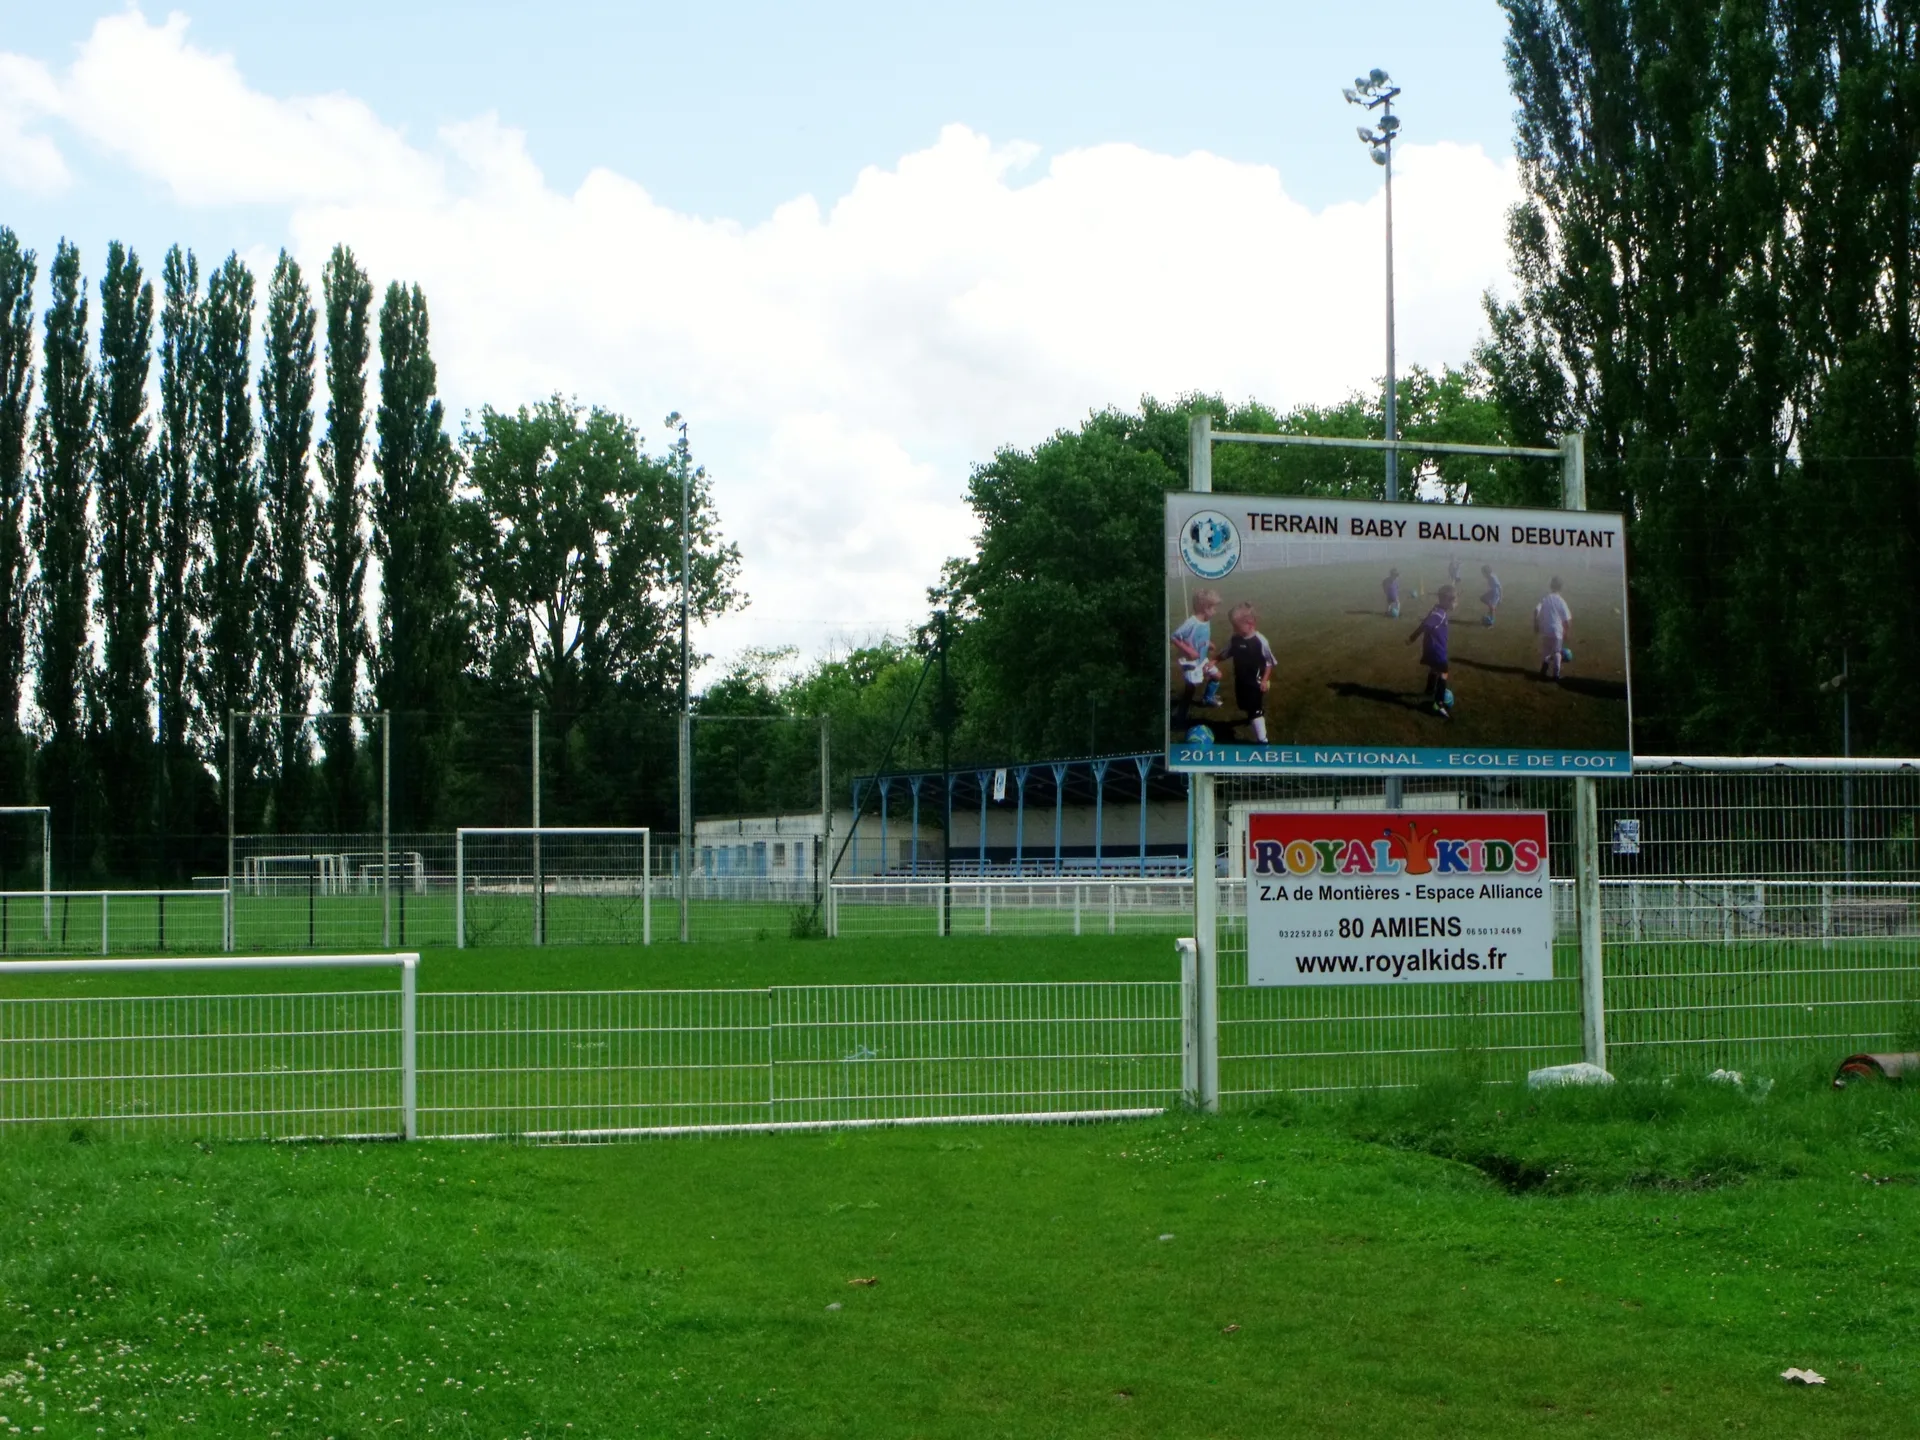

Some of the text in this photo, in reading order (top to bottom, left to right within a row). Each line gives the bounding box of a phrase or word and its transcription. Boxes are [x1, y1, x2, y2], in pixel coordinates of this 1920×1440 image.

[1247, 512, 1615, 548] TERRAIN BABY BALLON DEBUTANT
[1180, 750, 1226, 762] 2011
[1235, 751, 1307, 763] LABEL
[1314, 752, 1423, 765] NATIONAL
[1449, 754, 1520, 766] ECOLE
[1527, 755, 1555, 767] DE
[1562, 756, 1617, 768] FOOT
[1253, 839, 1540, 876] ROYAL KIDS
[1260, 886, 1288, 901] Z.A
[1293, 886, 1313, 900] de
[1319, 885, 1400, 901] Montières
[1416, 884, 1475, 903] Espace
[1479, 884, 1543, 900] Alliance
[1338, 916, 1462, 939] 80 AMIENS
[1295, 947, 1507, 978] www.royalkids.fr
